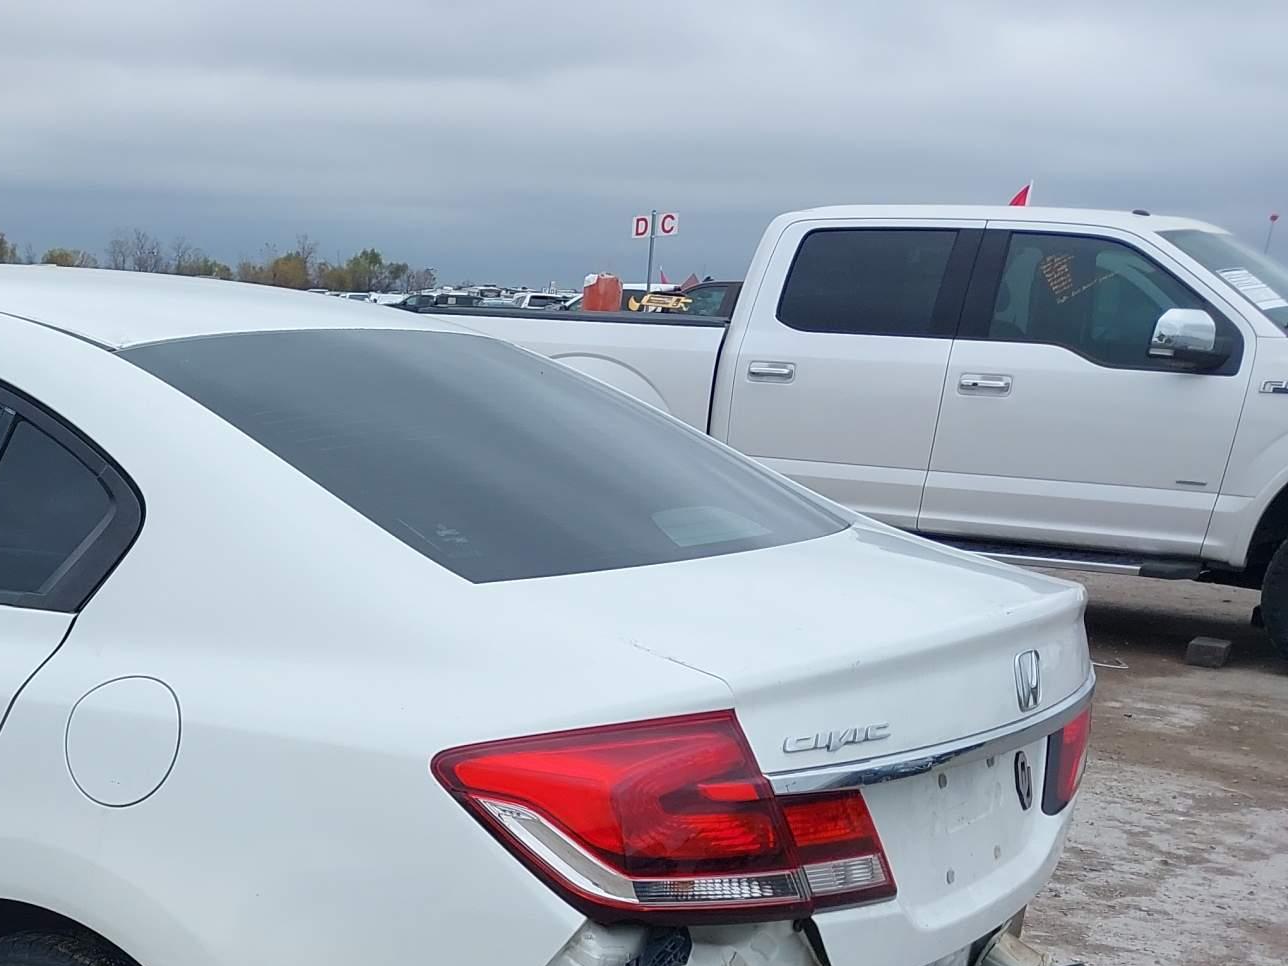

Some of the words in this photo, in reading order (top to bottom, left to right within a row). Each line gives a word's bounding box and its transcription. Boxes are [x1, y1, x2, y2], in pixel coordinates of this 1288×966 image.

[635, 217, 649, 236] D
[661, 214, 675, 234] C
[783, 722, 891, 755] CIVIC
